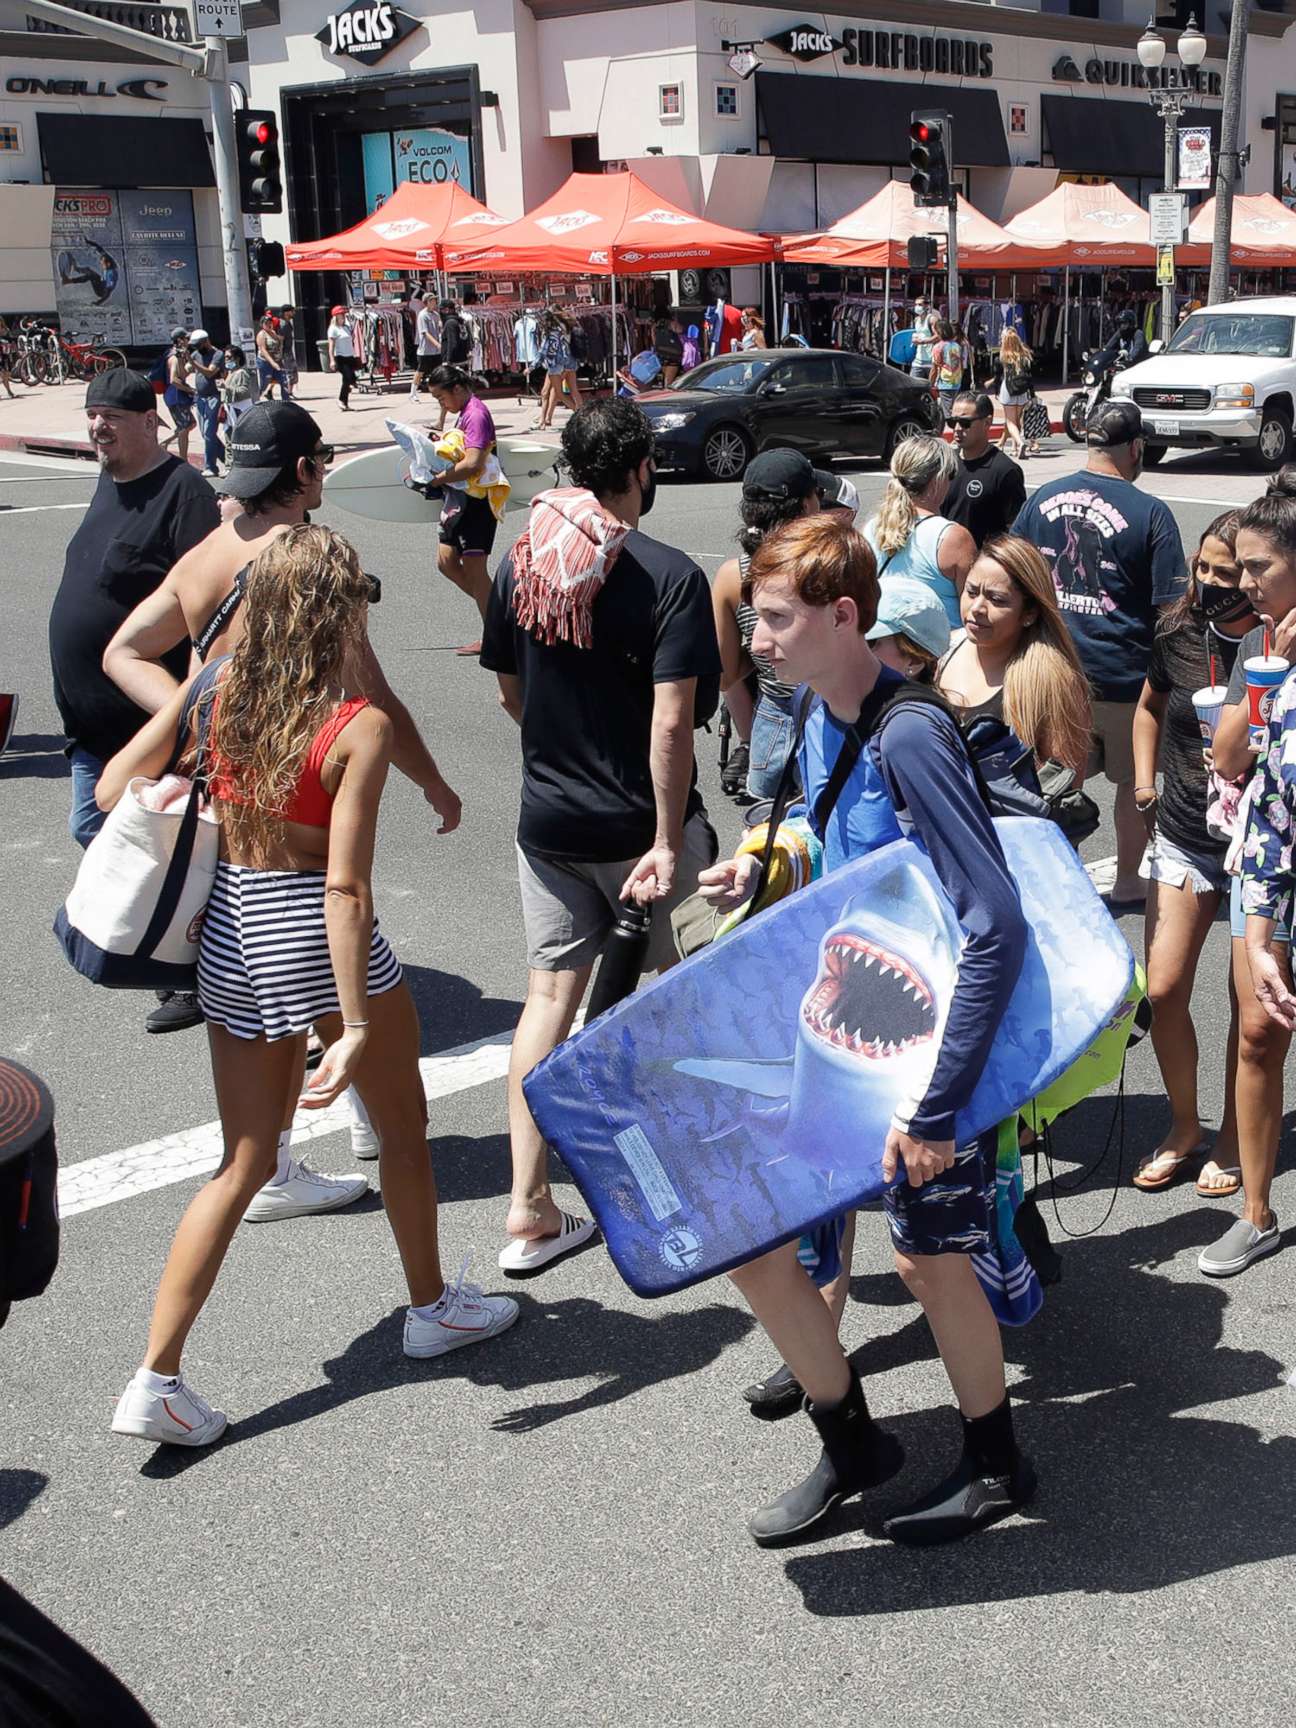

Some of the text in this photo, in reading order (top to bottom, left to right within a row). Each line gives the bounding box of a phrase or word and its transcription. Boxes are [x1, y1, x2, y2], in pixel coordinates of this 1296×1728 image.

[198, 4, 238, 15] ROUTE
[327, 0, 395, 52] JACK'S
[790, 29, 994, 78] JACK'S SURFBOARDS
[6, 77, 117, 98] O'NEILL
[413, 145, 452, 157] VOLCOM
[408, 158, 448, 184] ECO
[139, 204, 173, 216] Jeep
[1061, 504, 1085, 518] ALL
[1084, 509, 1115, 539] SIZES
[1206, 592, 1243, 616] GUCC
